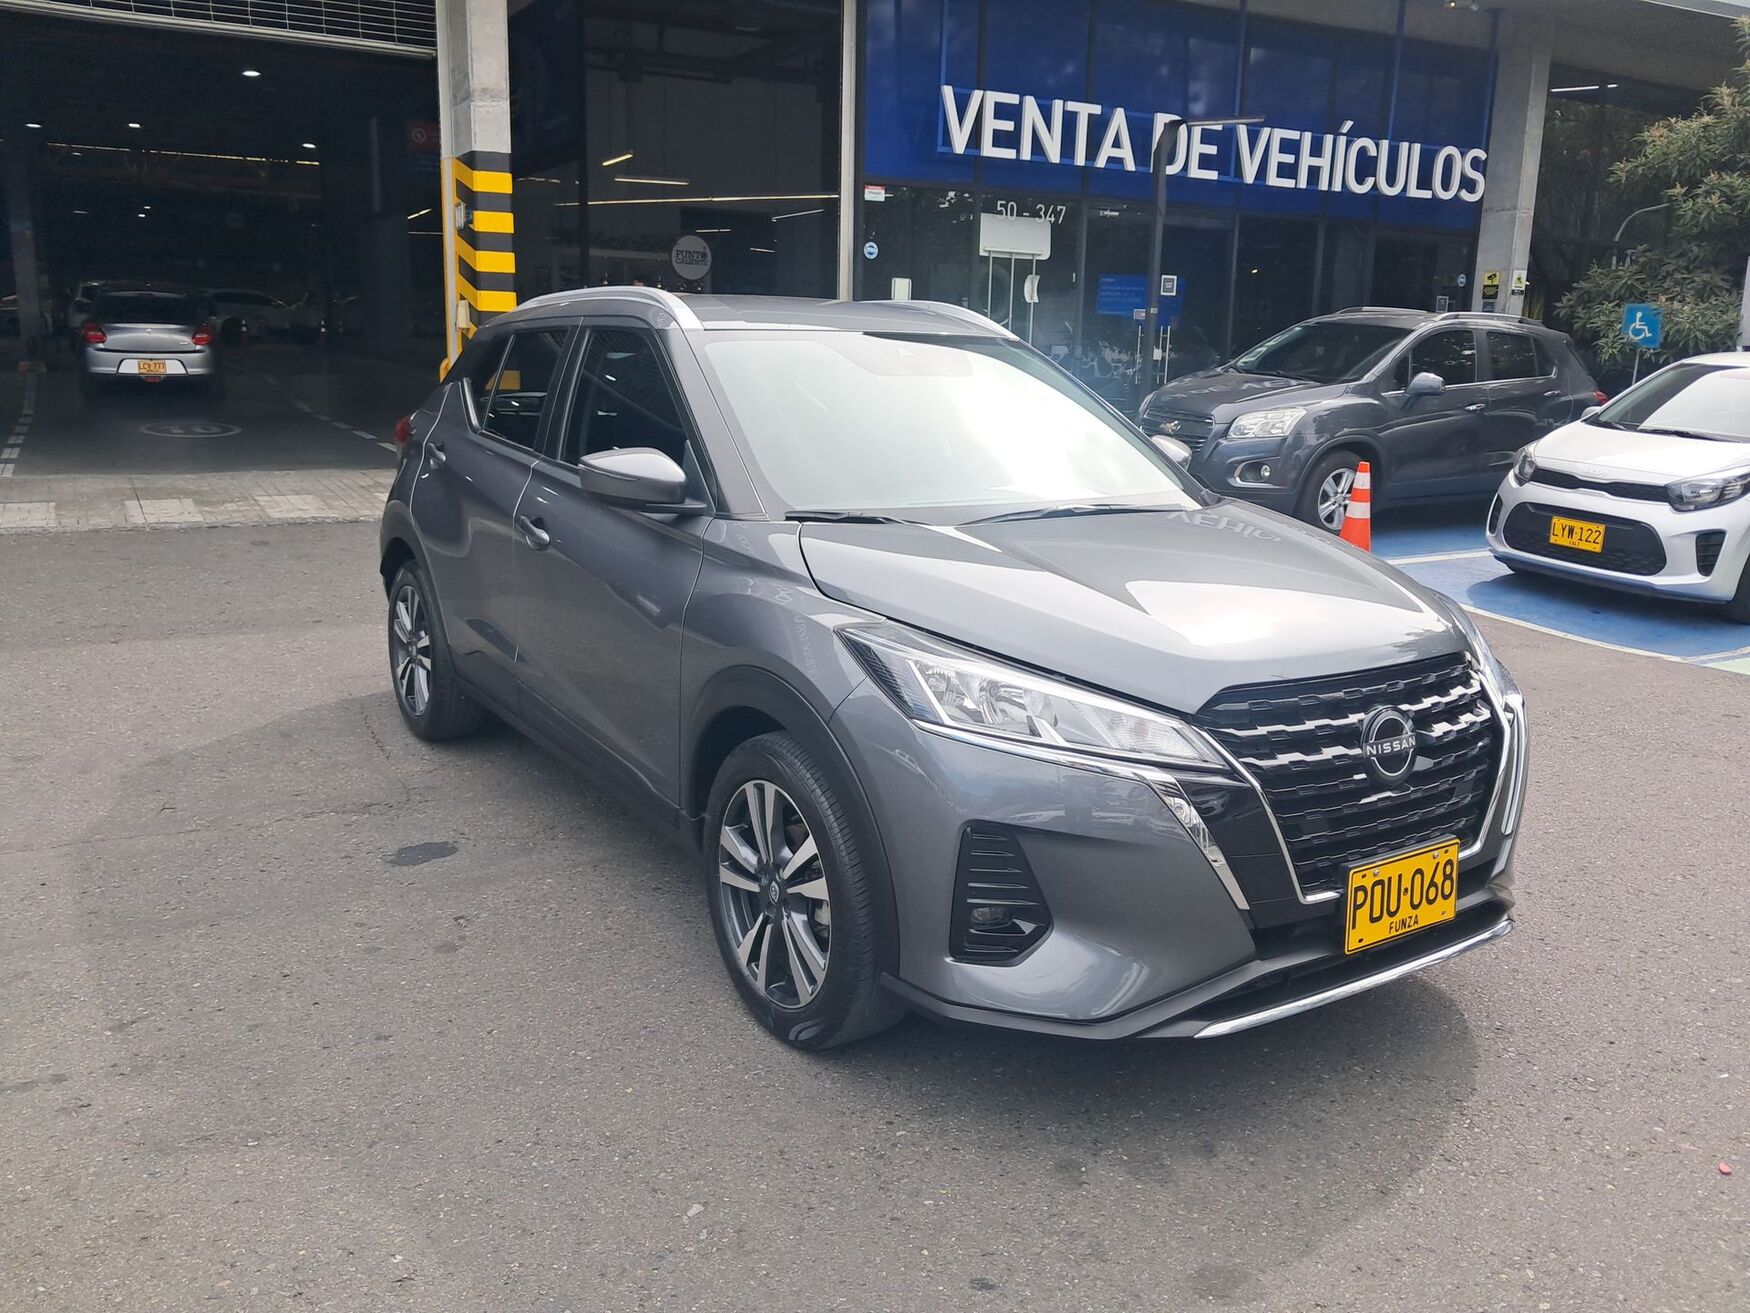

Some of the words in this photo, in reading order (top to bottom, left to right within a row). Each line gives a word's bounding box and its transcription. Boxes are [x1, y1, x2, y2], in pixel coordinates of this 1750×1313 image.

[940, 84, 1136, 172] VENTA
[1150, 112, 1223, 181] DE
[1236, 119, 1488, 203] VEHÍCULOS
[996, 200, 1017, 221] 50
[1035, 203, 1067, 225] 347
[1366, 734, 1417, 756] NISSAN
[1388, 912, 1420, 936] FUNZA
